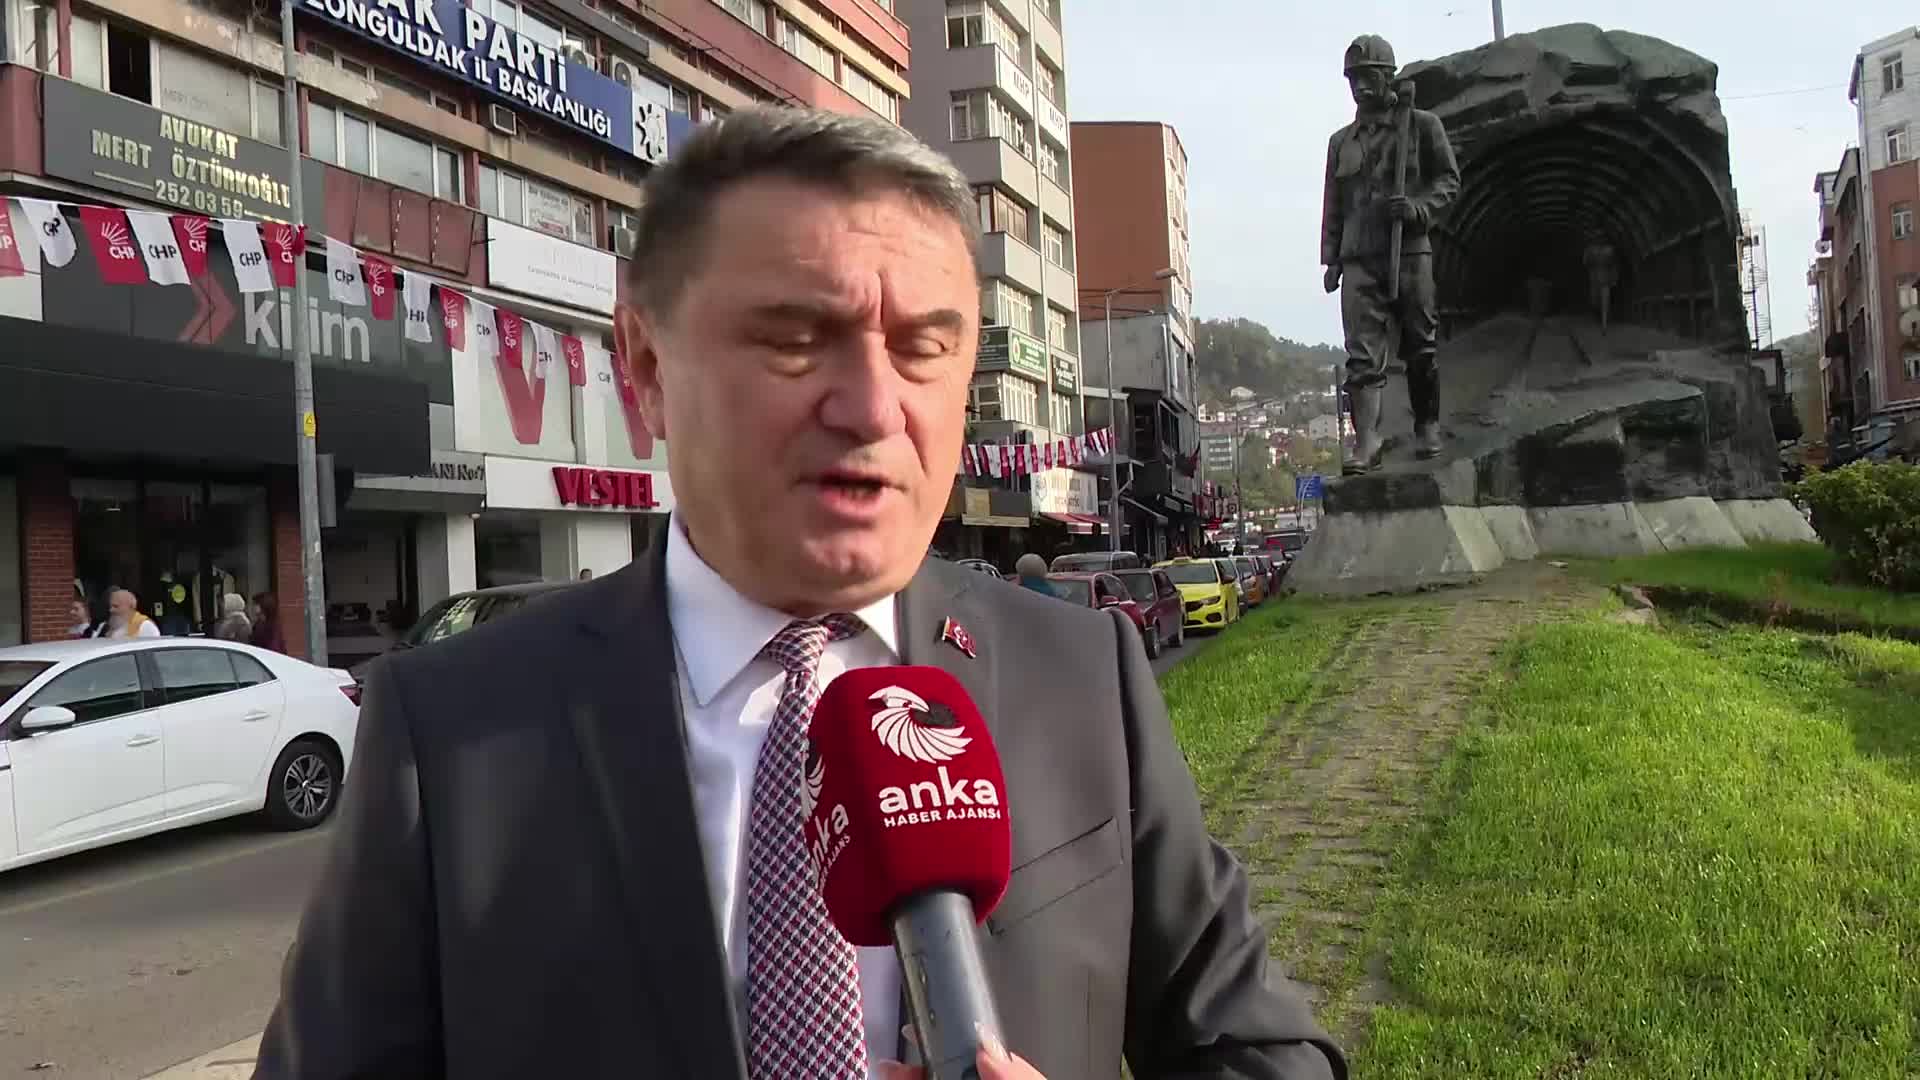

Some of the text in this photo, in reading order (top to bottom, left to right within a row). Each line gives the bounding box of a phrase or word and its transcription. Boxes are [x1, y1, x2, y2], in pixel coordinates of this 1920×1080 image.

[498, 67, 612, 138] BAŞKANLIĞI
[159, 114, 238, 160] AVUKAT
[92, 129, 291, 208] MERT ÖZTÜRKOĞLU
[155, 179, 244, 220] 252 03 59
[148, 244, 177, 260] CHP
[239, 251, 263, 267] CHP
[244, 291, 370, 362] kiim
[552, 466, 660, 509] VESTEL
[878, 766, 999, 814] anka
[884, 809, 942, 828] HABER
